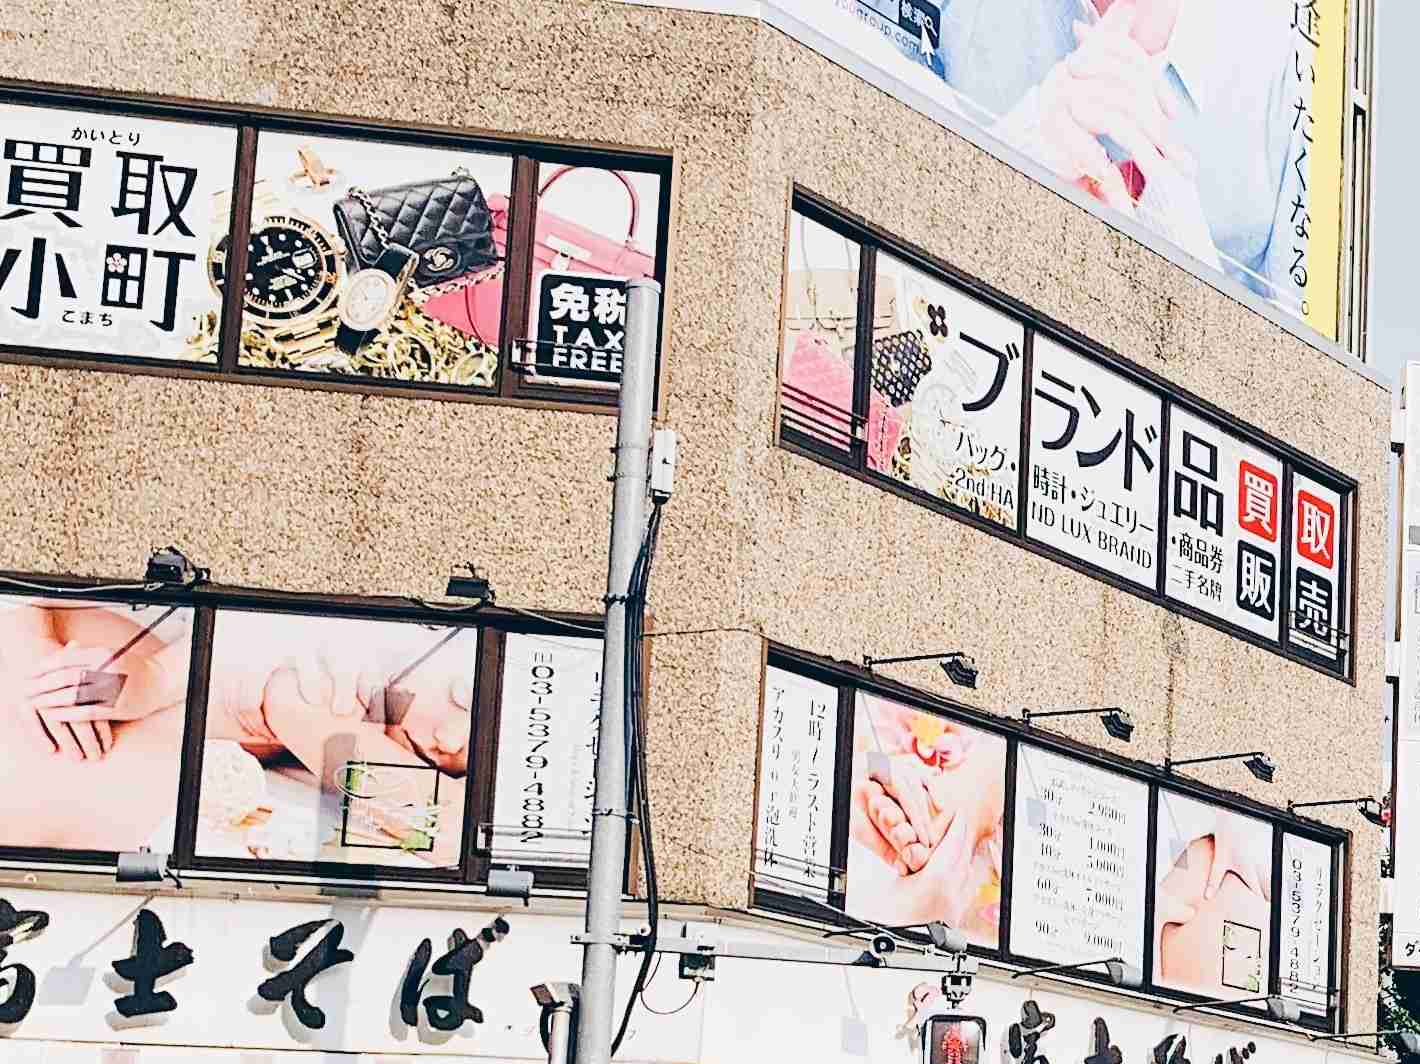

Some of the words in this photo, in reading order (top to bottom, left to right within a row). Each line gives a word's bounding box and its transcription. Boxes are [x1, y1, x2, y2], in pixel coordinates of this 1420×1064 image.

[71, 127, 142, 147] かいとり
[3, 139, 198, 239] 買取
[0, 237, 197, 332] 小町
[548, 282, 628, 325] 免税
[62, 309, 115, 328] こまち
[551, 325, 625, 351] TAX
[551, 348, 624, 374] FREE
[954, 467, 985, 497] 2nd
[1061, 514, 1092, 544] LUX
[1098, 530, 1152, 569] BRAND
[1243, 471, 1331, 561] 買取
[1239, 551, 1330, 636] 販売
